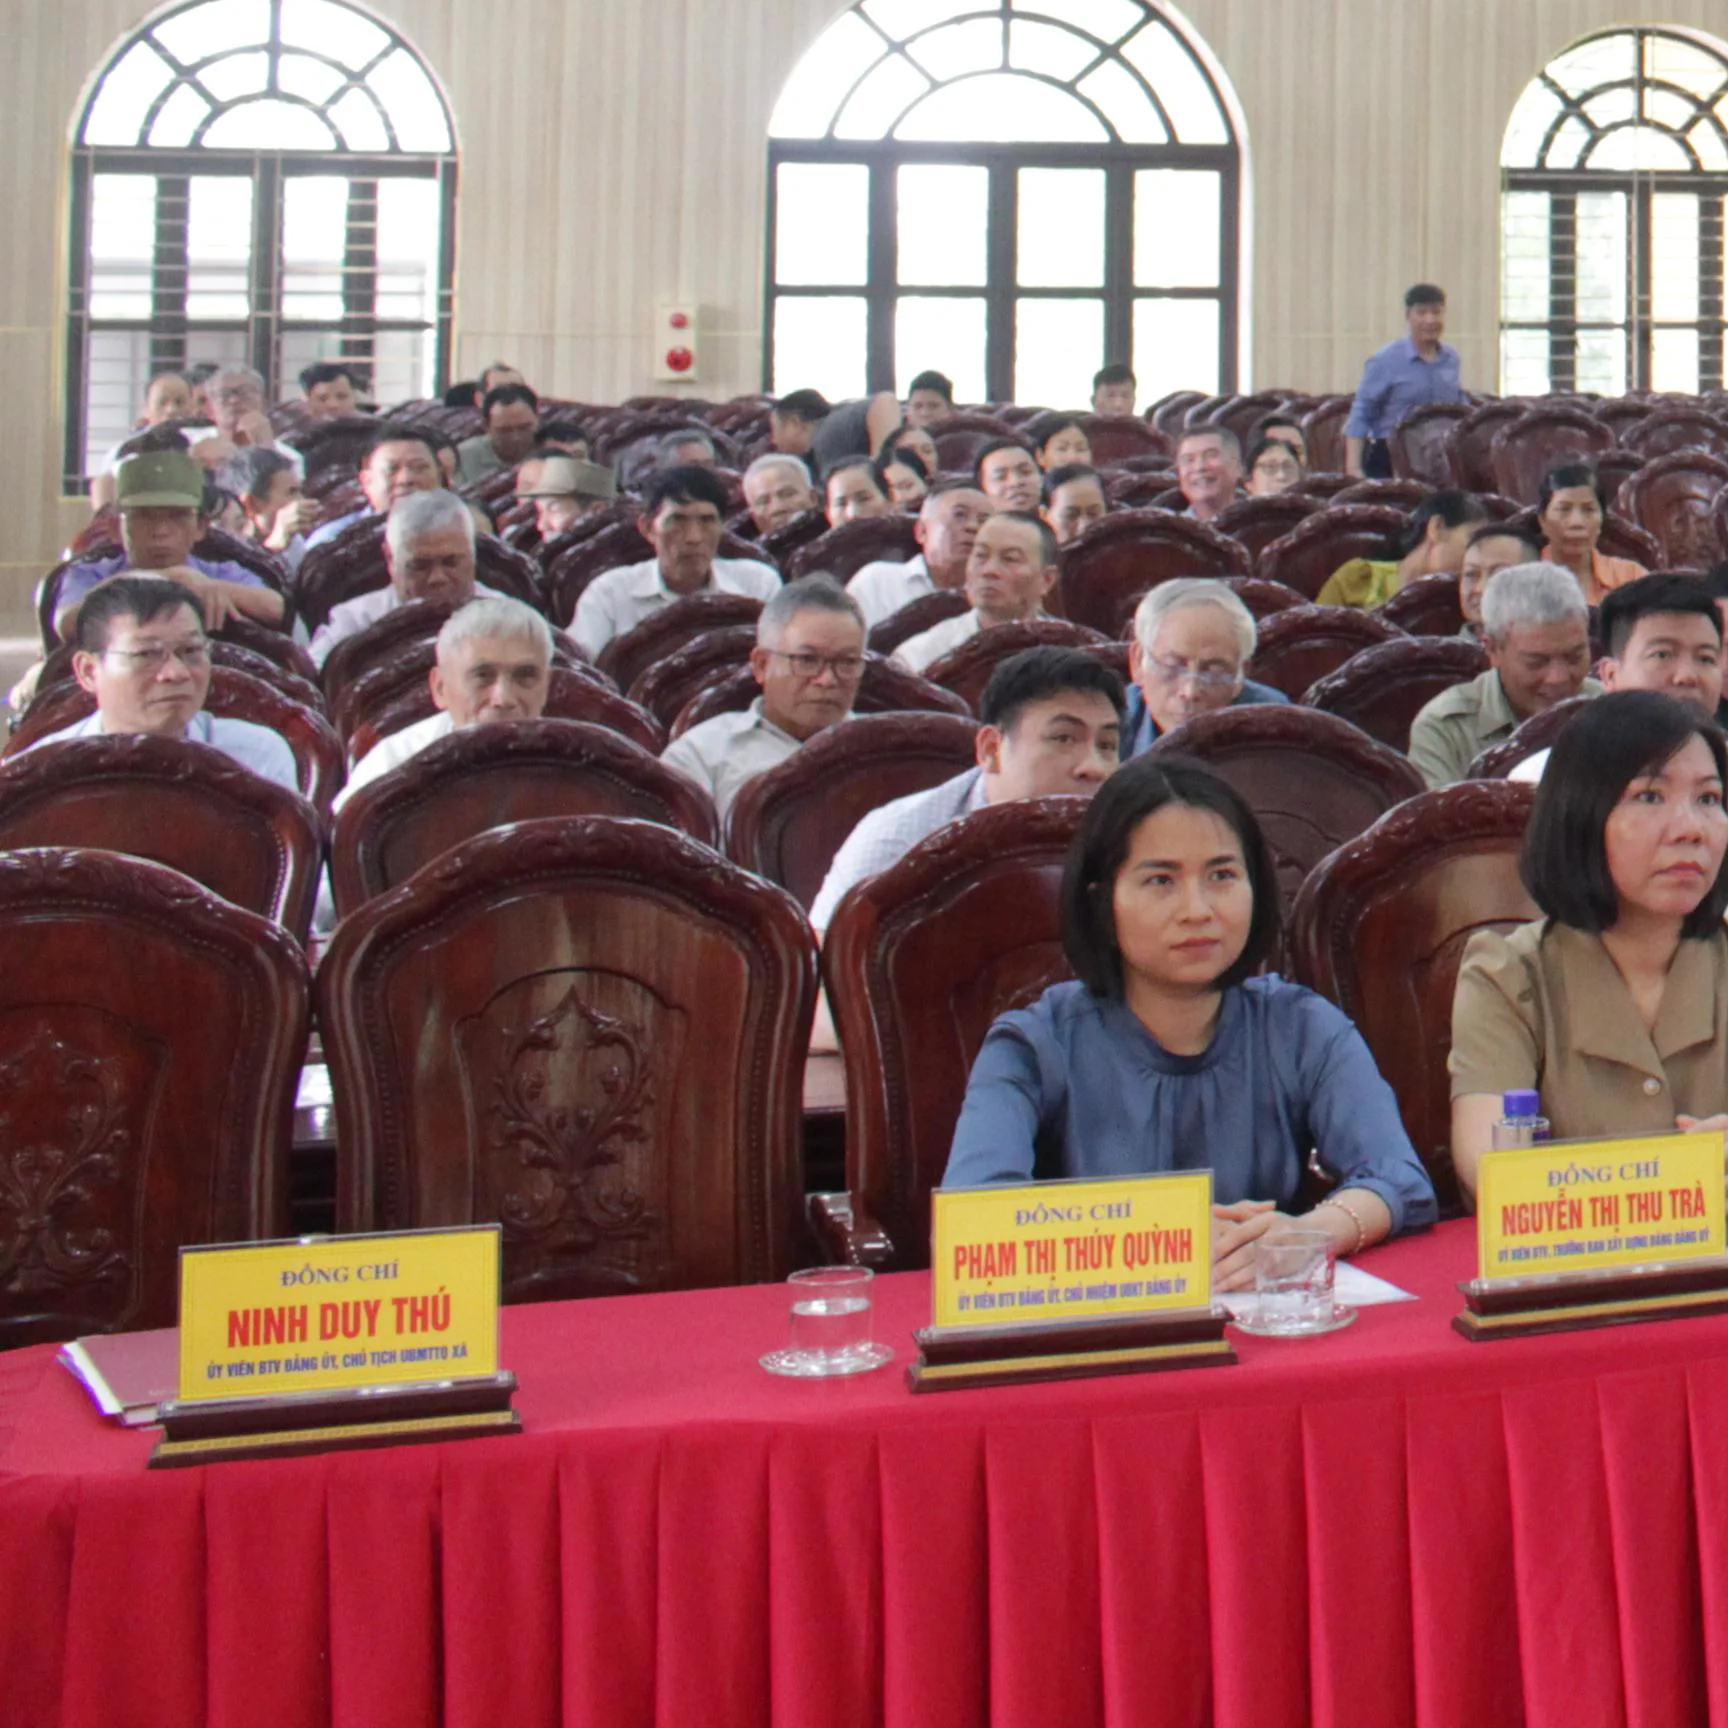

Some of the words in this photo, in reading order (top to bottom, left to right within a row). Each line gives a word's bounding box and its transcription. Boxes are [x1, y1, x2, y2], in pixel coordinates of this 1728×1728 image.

[1547, 1162, 1612, 1187] ĐỒNG
[1619, 1156, 1660, 1180] CHÍ
[1016, 1203, 1083, 1227] ĐỒNG
[1090, 1200, 1132, 1220] CHÍ
[1502, 1188, 1582, 1236] NGUYỄN
[1589, 1194, 1619, 1232] THỊ
[1626, 1191, 1663, 1224] THU
[1669, 1180, 1706, 1218] TRÀ
[954, 1241, 1016, 1286] PHẠM
[1024, 1238, 1056, 1281] THỊ
[1123, 1223, 1192, 1270] QUỲNH
[281, 1264, 349, 1287] ĐỒNG
[357, 1260, 399, 1281] CHÍ
[227, 1305, 307, 1348] NINH
[320, 1300, 380, 1341] DUY
[392, 1285, 451, 1335] THÚ
[228, 1361, 254, 1377] VIÊN
[259, 1361, 280, 1375] BTV
[285, 1353, 318, 1373] ĐẢNG
[343, 1348, 367, 1368] CHỦ
[370, 1349, 396, 1368] TỊCH
